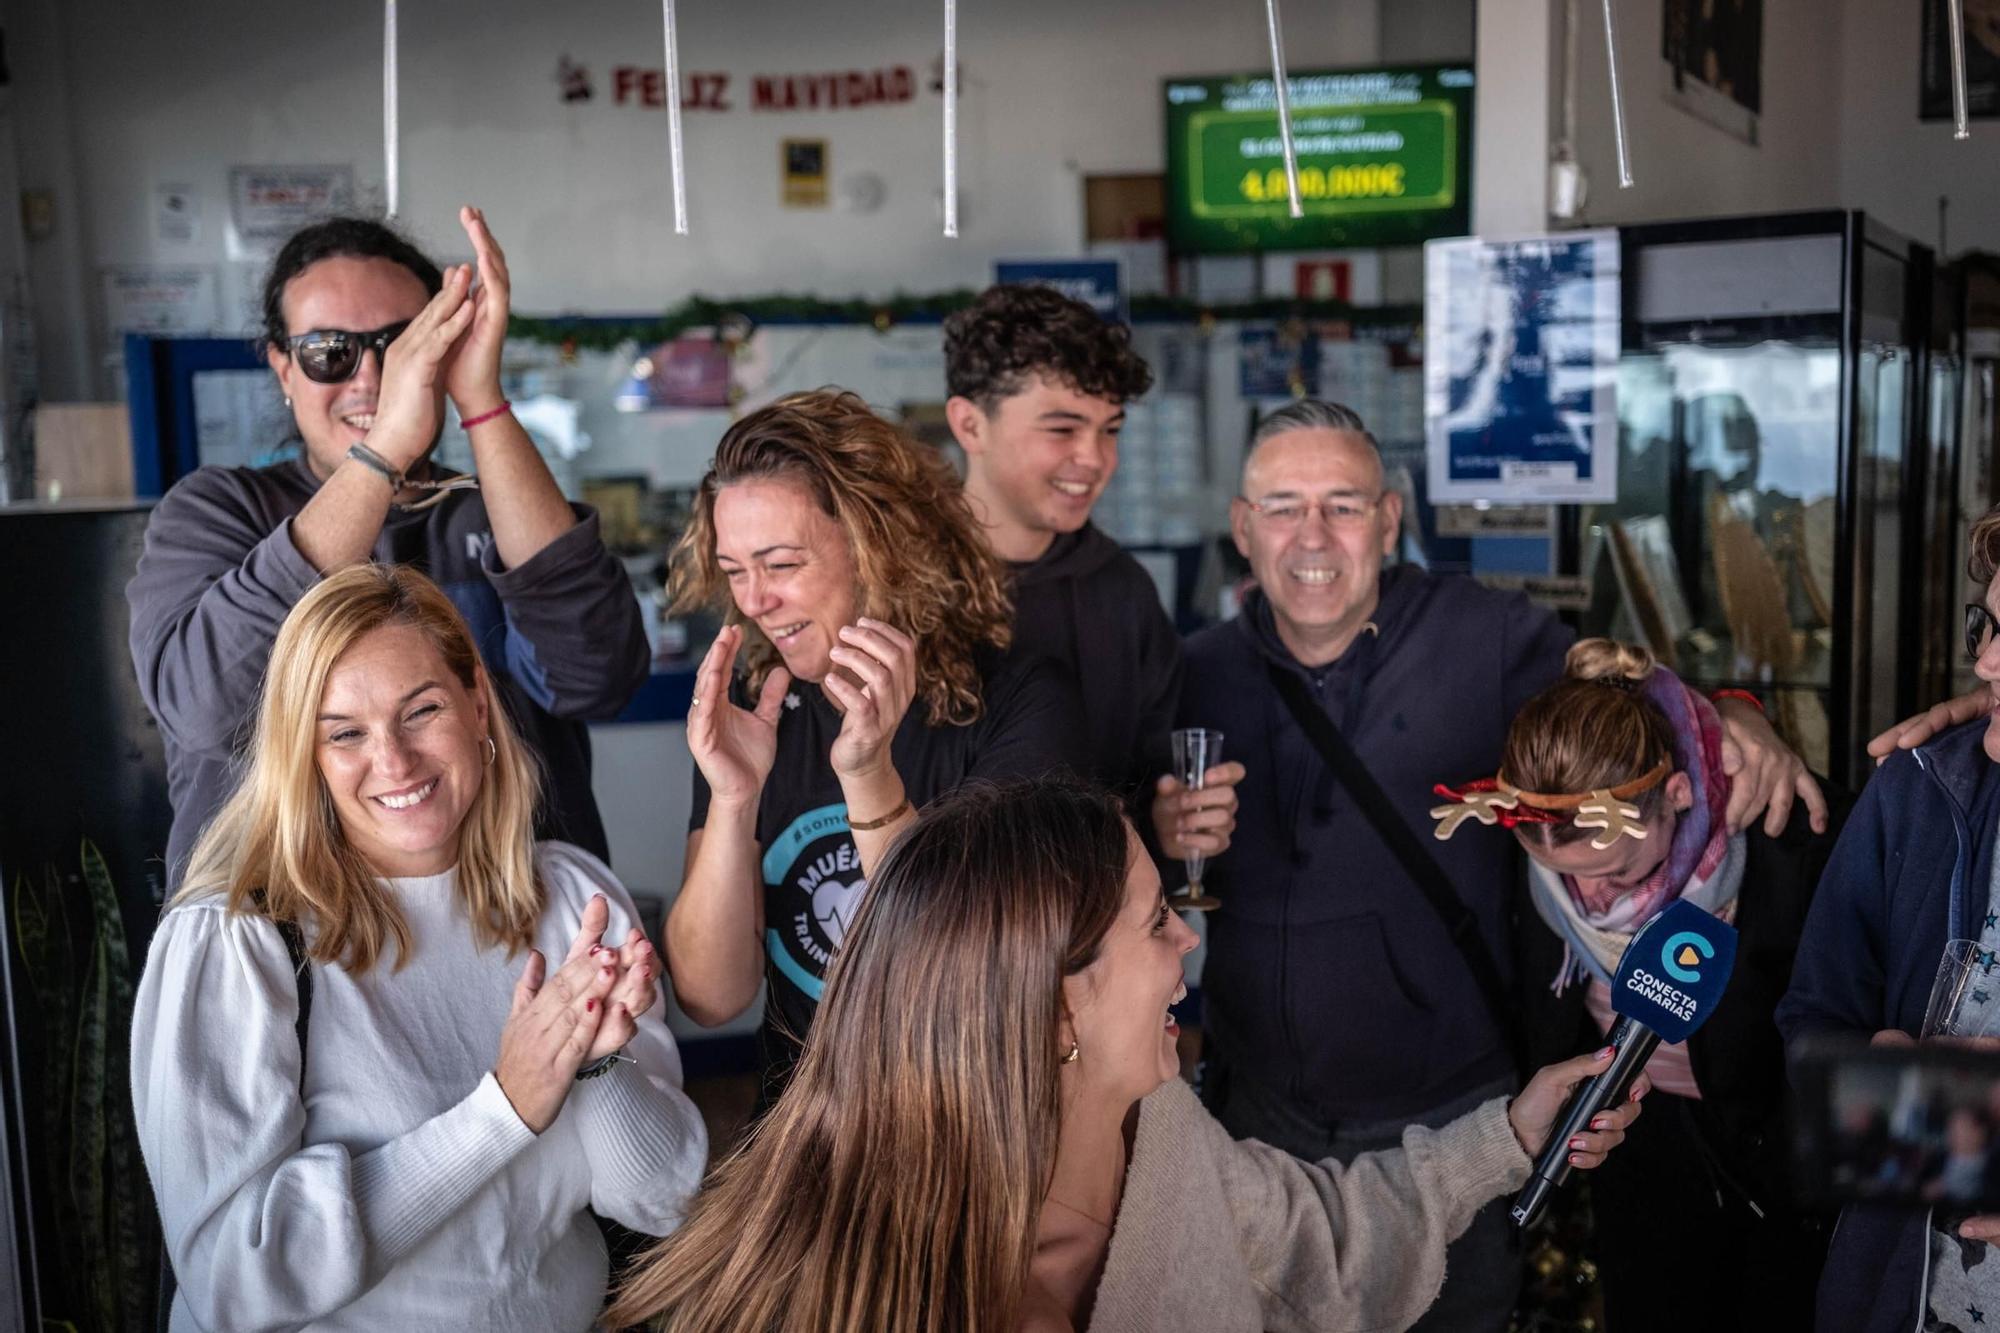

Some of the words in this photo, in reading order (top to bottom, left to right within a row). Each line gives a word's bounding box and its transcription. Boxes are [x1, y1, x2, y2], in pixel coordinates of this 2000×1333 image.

[753, 64, 914, 111] NAVIDAD
[1626, 978, 1693, 1021] CANARIAS
[1633, 968, 1697, 1012] CONECTA
